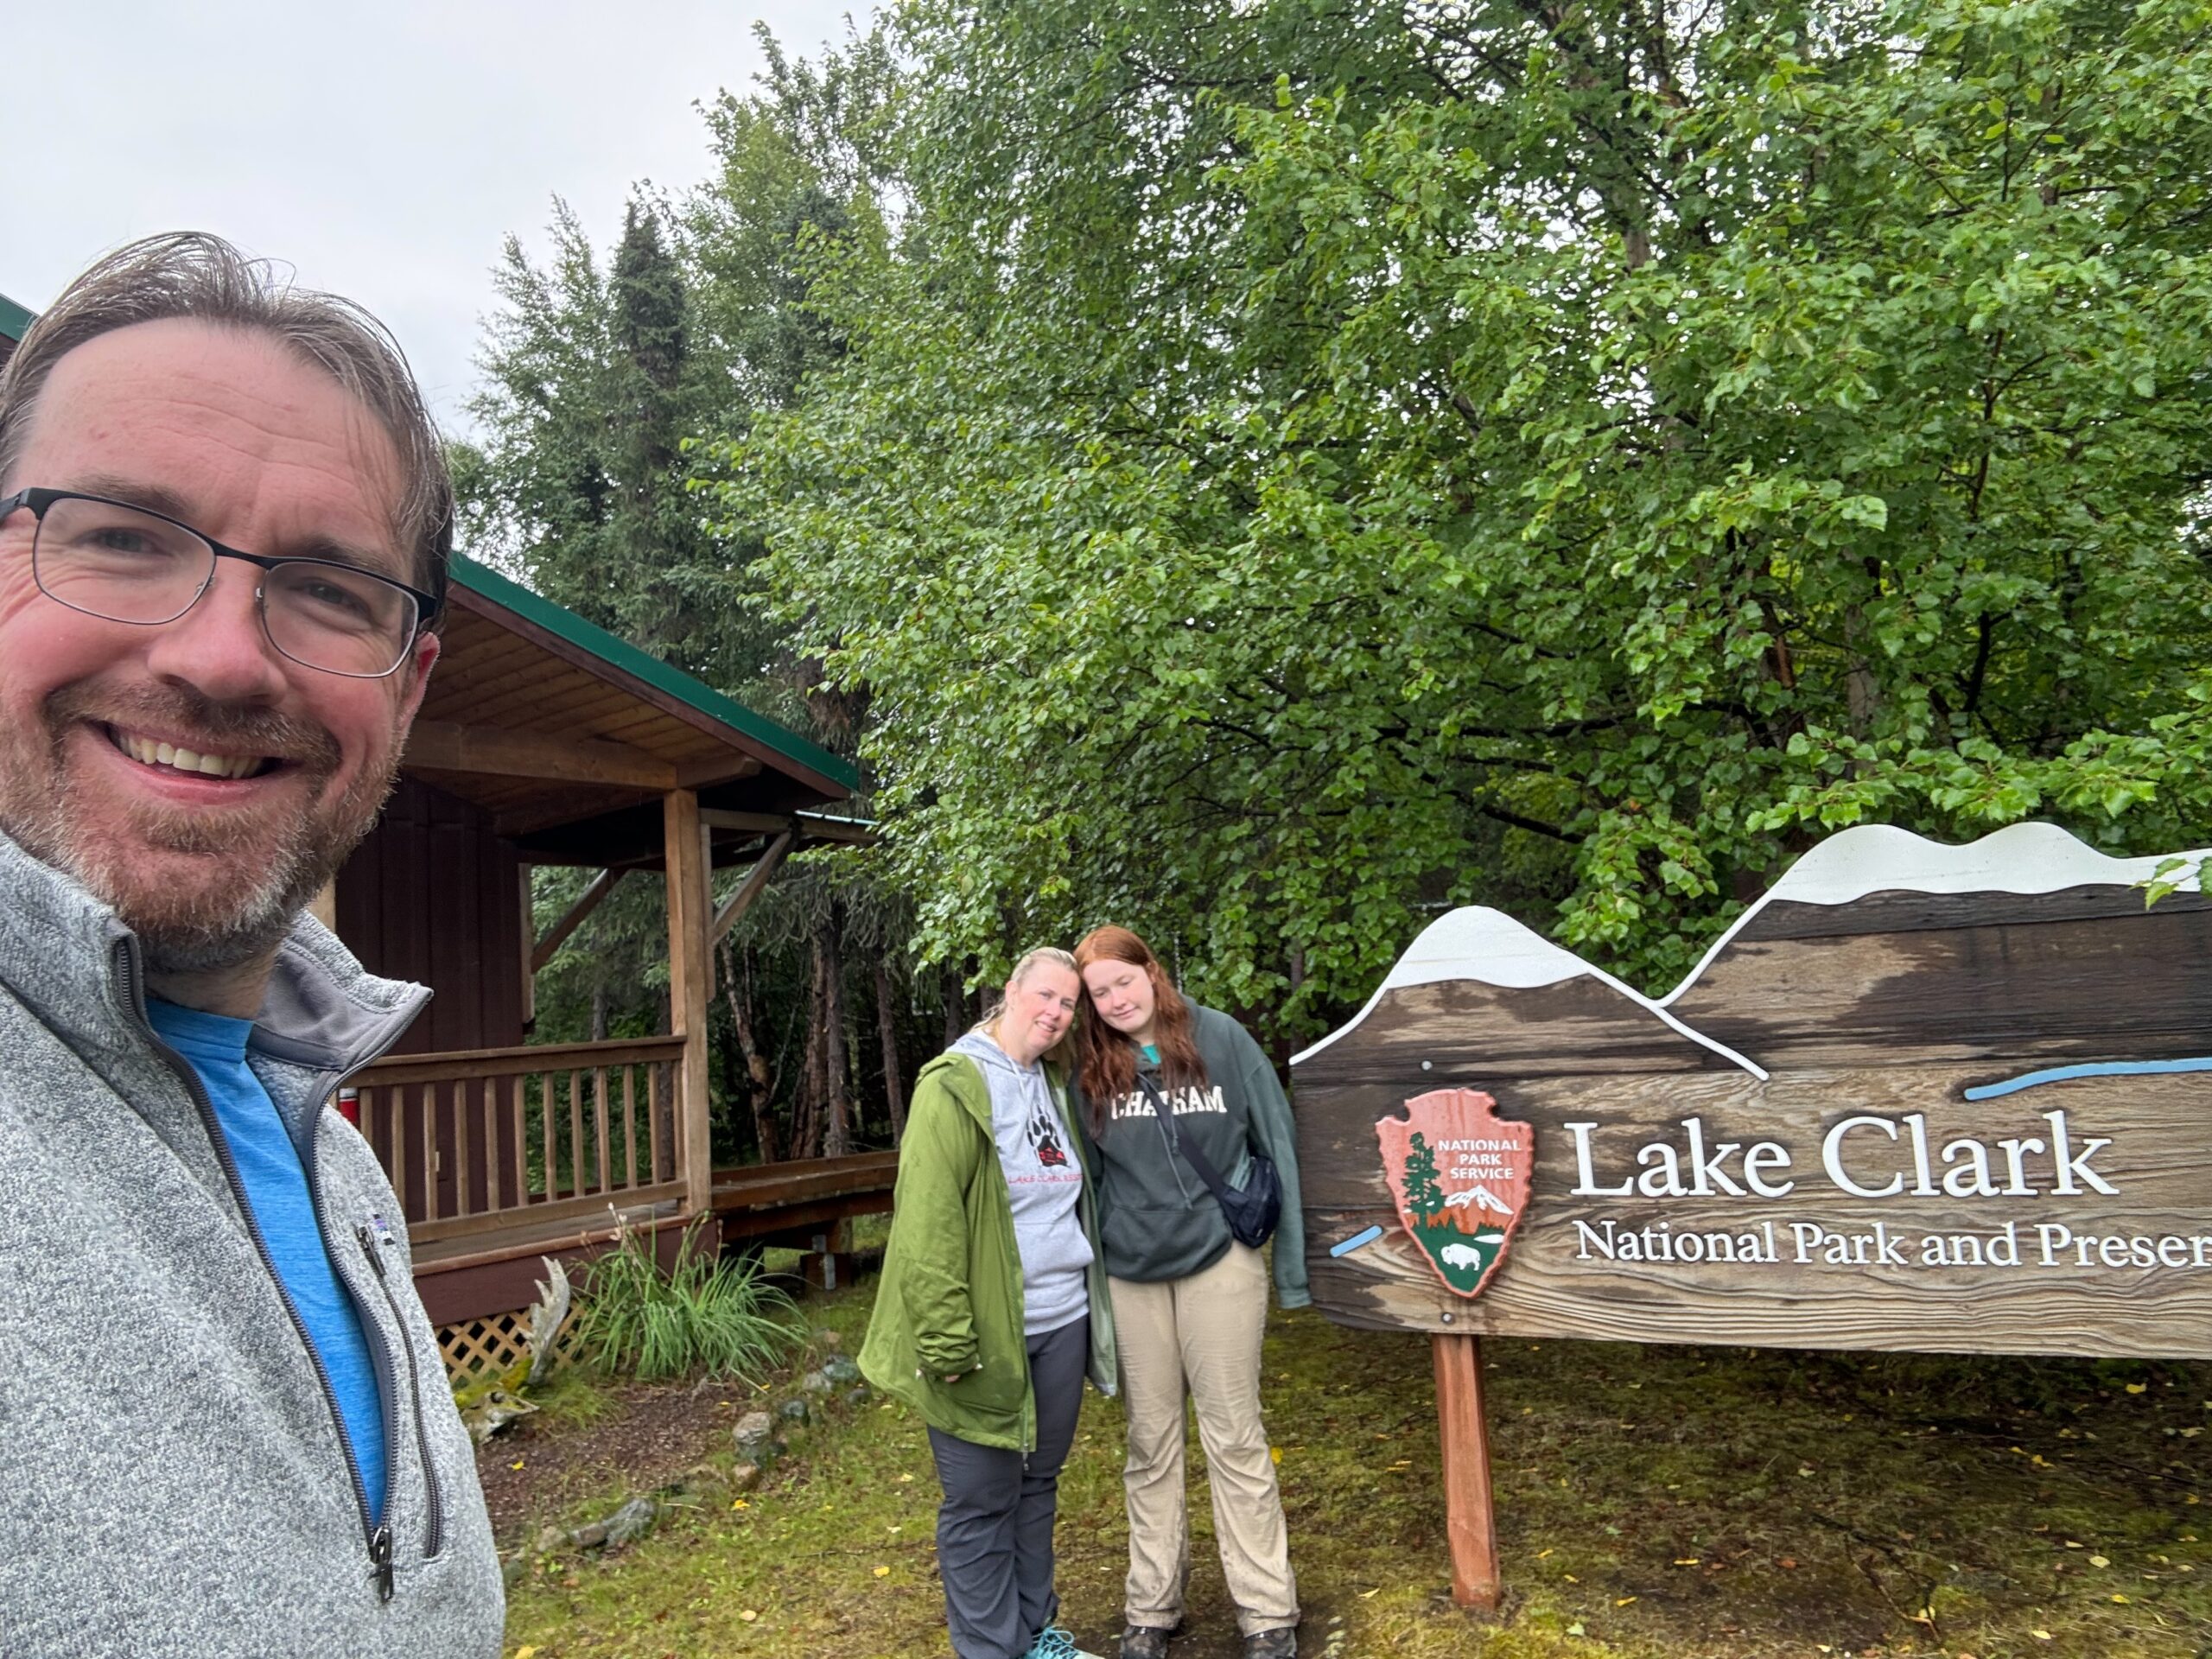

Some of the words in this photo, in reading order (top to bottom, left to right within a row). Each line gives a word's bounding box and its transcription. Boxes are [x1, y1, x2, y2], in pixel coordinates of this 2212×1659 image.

[1438, 1139, 1522, 1152] NATIONAL
[1459, 1154, 1503, 1165] PARK
[1564, 1116, 1795, 1198] Lake
[1821, 1109, 2120, 1198] Clark
[1450, 1167, 1515, 1180] SERVICE
[1572, 1219, 1781, 1263] National
[1788, 1221, 1909, 1265] Park
[1920, 1221, 2023, 1267] and
[2033, 1223, 2212, 1268] Preser
